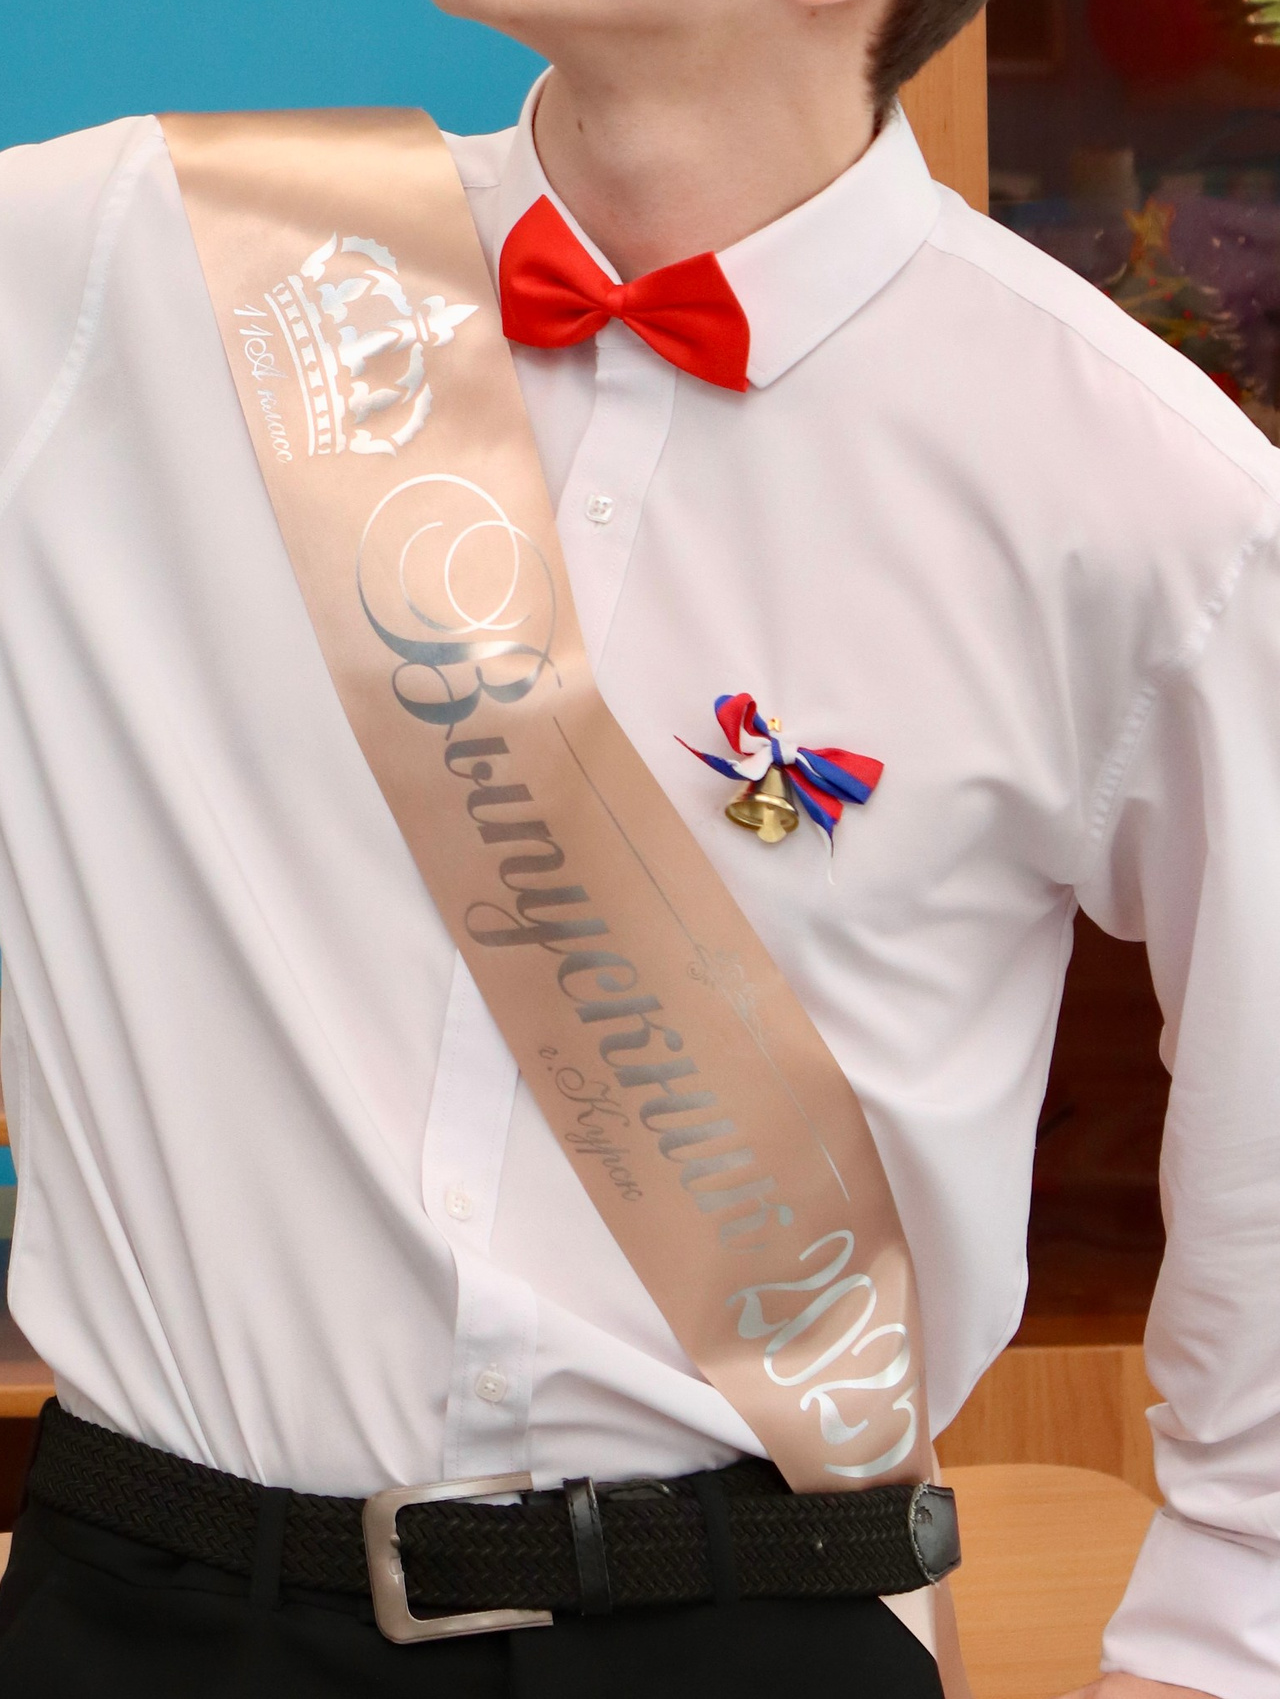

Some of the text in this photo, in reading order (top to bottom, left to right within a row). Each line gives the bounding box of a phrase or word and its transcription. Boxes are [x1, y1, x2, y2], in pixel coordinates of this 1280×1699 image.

[257, 389, 293, 464] класс
[356, 472, 795, 1256] Выпускник
[725, 1228, 920, 1480] 2023
